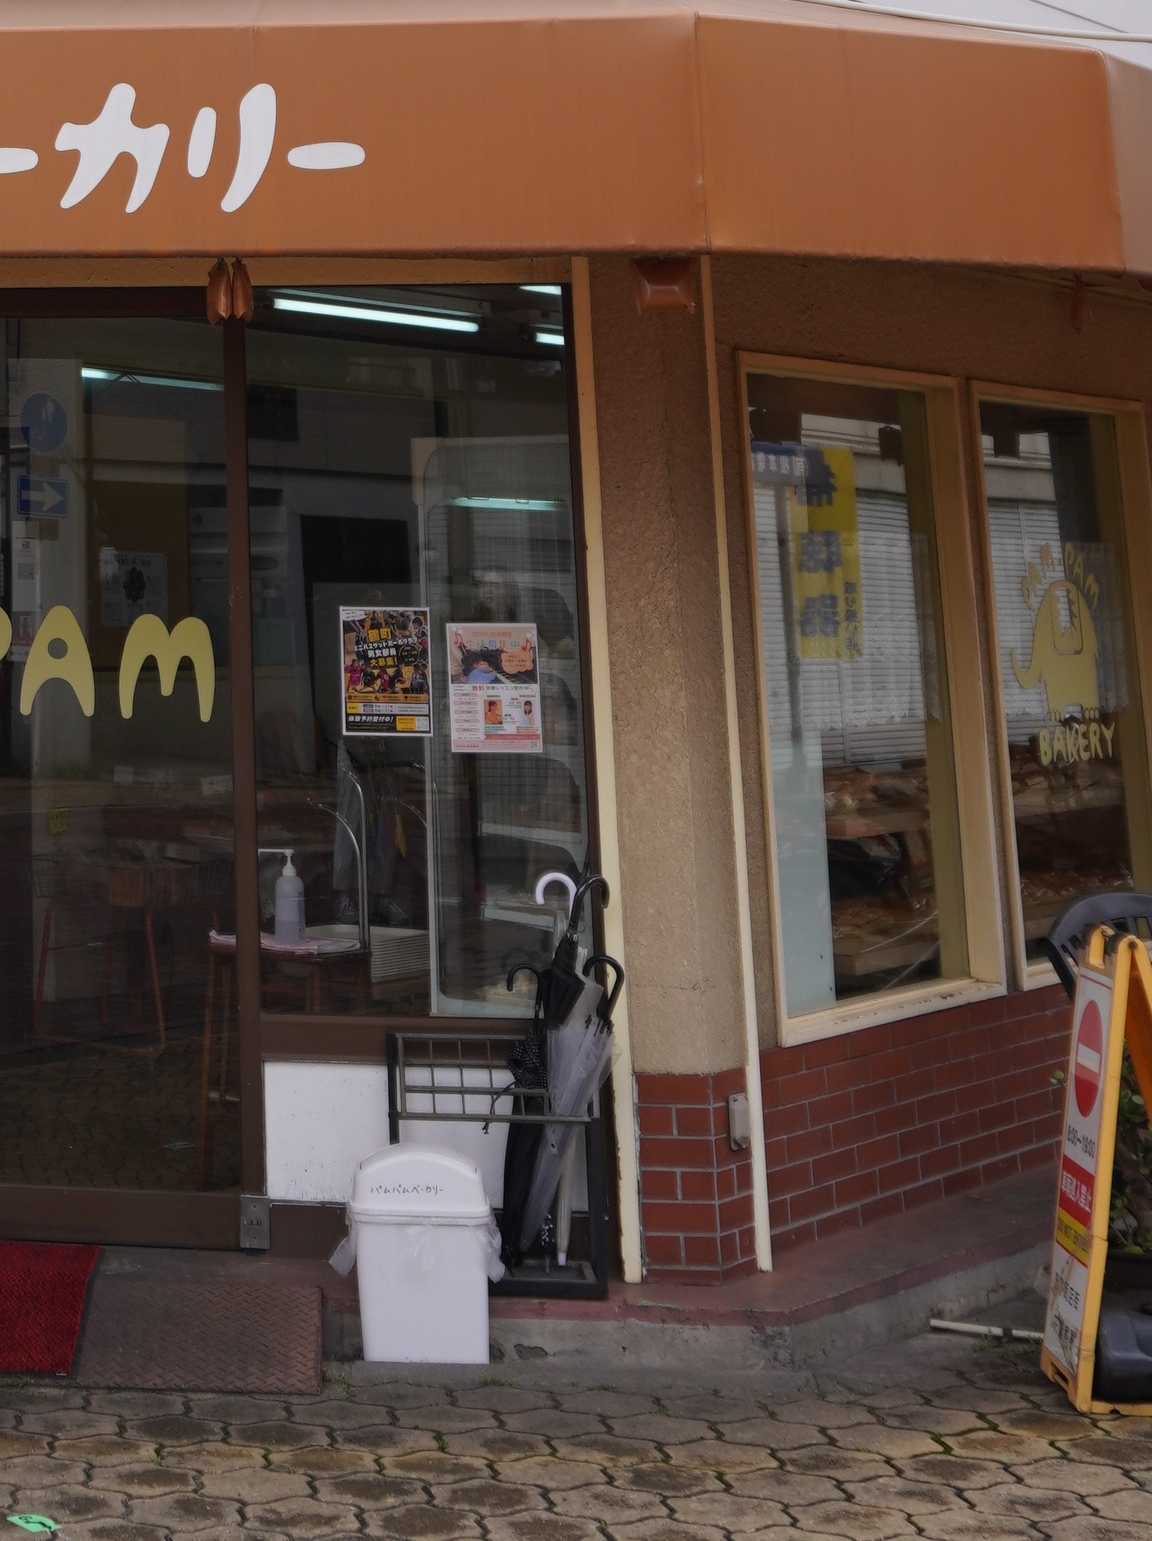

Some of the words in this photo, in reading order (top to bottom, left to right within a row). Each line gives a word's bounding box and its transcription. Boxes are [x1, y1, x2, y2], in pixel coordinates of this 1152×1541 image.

[1065, 542, 1100, 612] PAM
[1039, 722, 1116, 766] BAKERY
[370, 1184, 444, 1196] パムパムベーカリー
